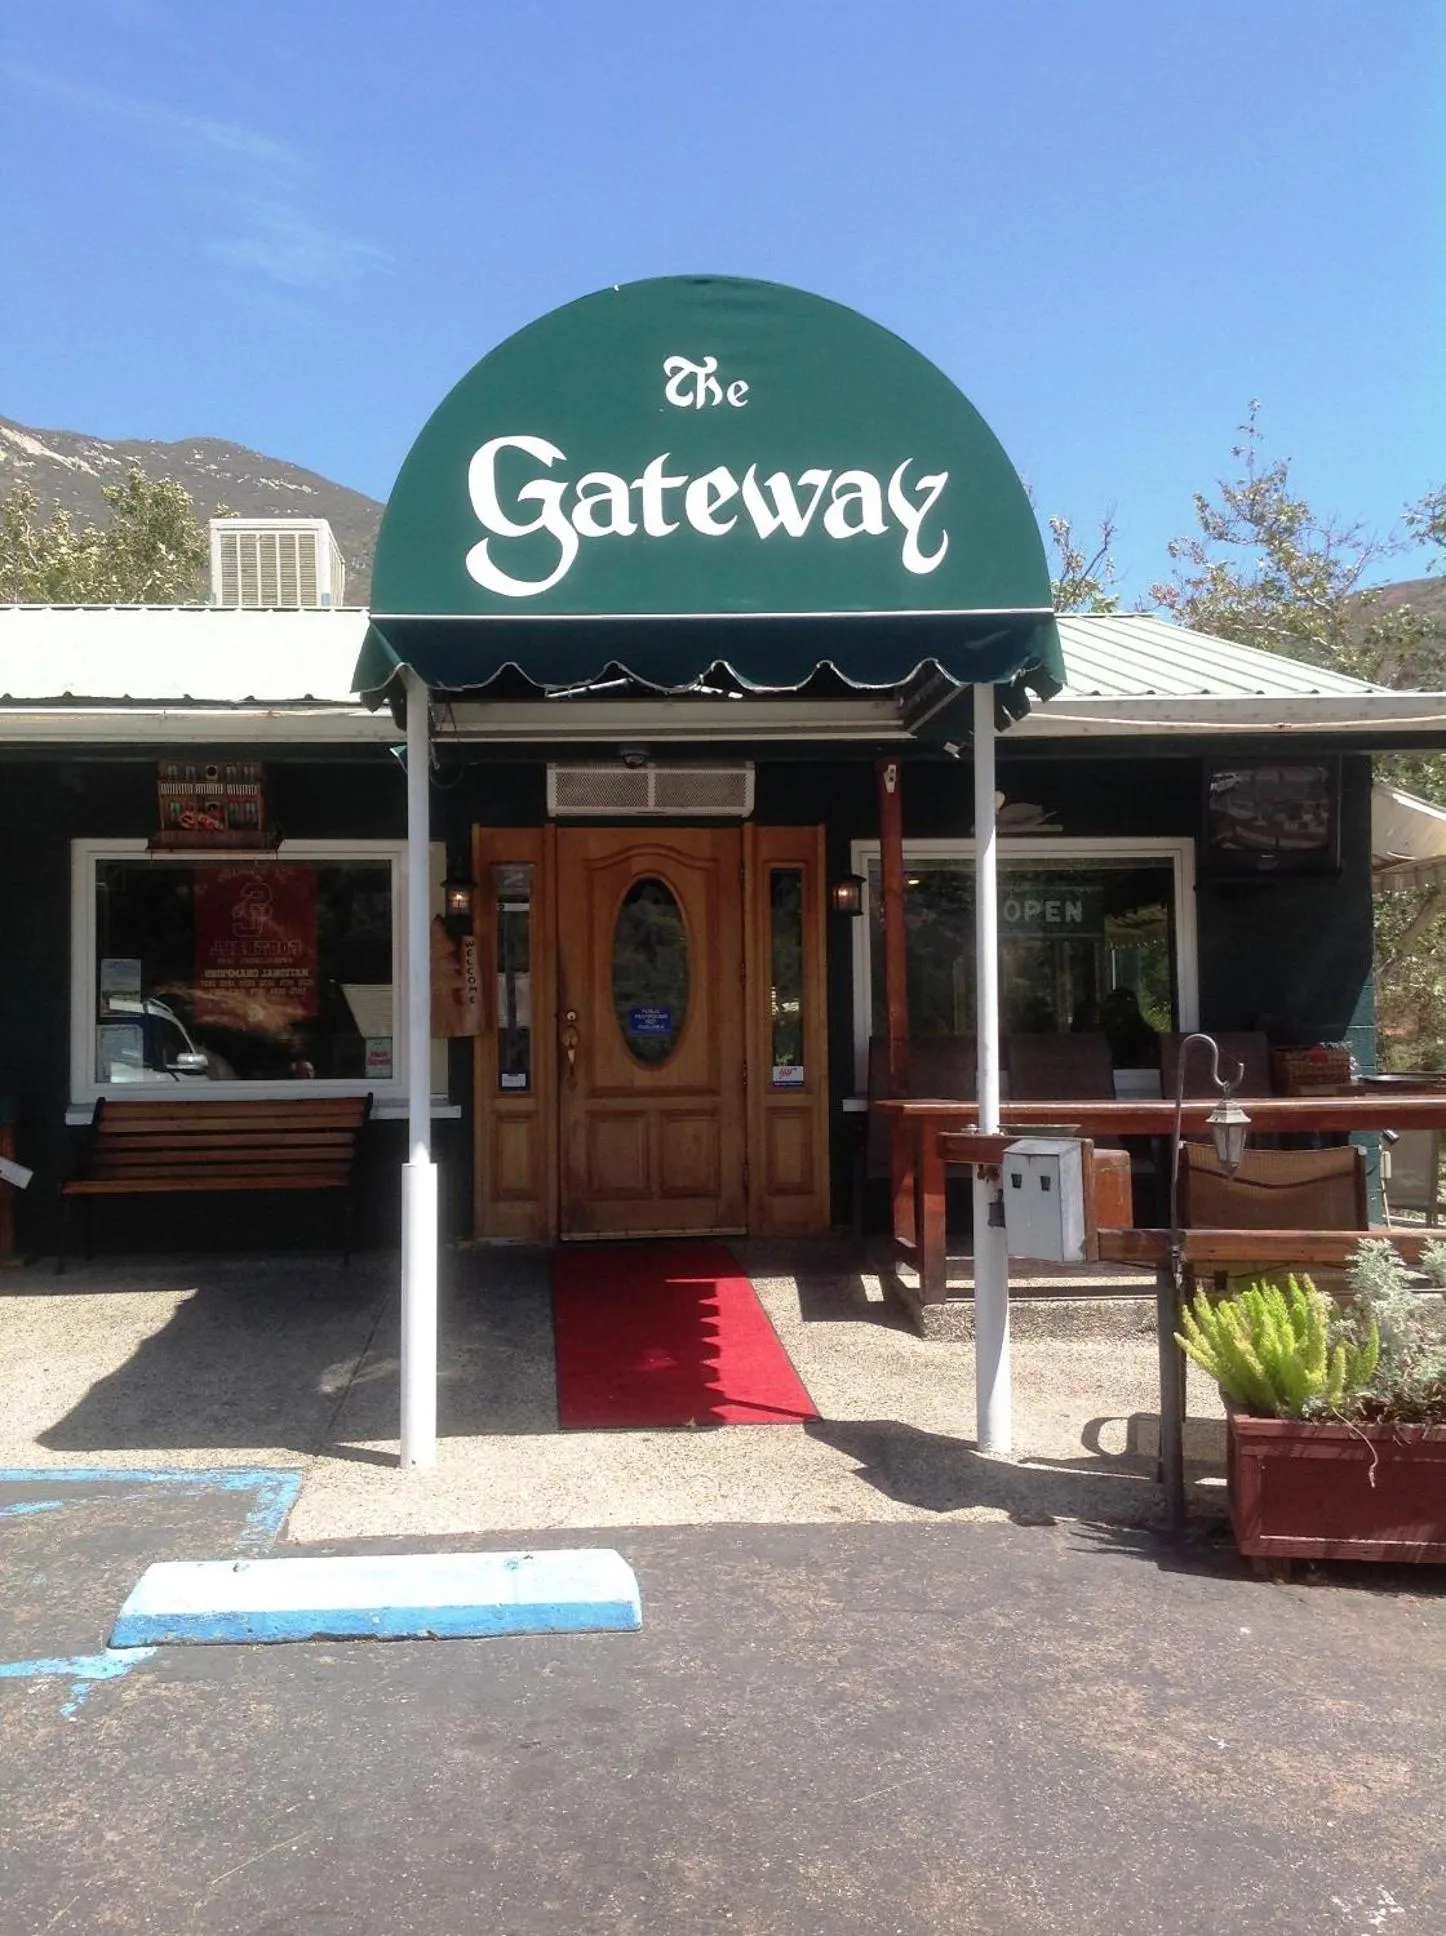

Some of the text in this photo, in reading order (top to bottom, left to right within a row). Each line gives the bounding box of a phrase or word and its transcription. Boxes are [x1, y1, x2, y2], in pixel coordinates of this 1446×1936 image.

[663, 355, 749, 410] The
[465, 435, 948, 597] Gateway
[1004, 900, 1083, 923] OPEN
